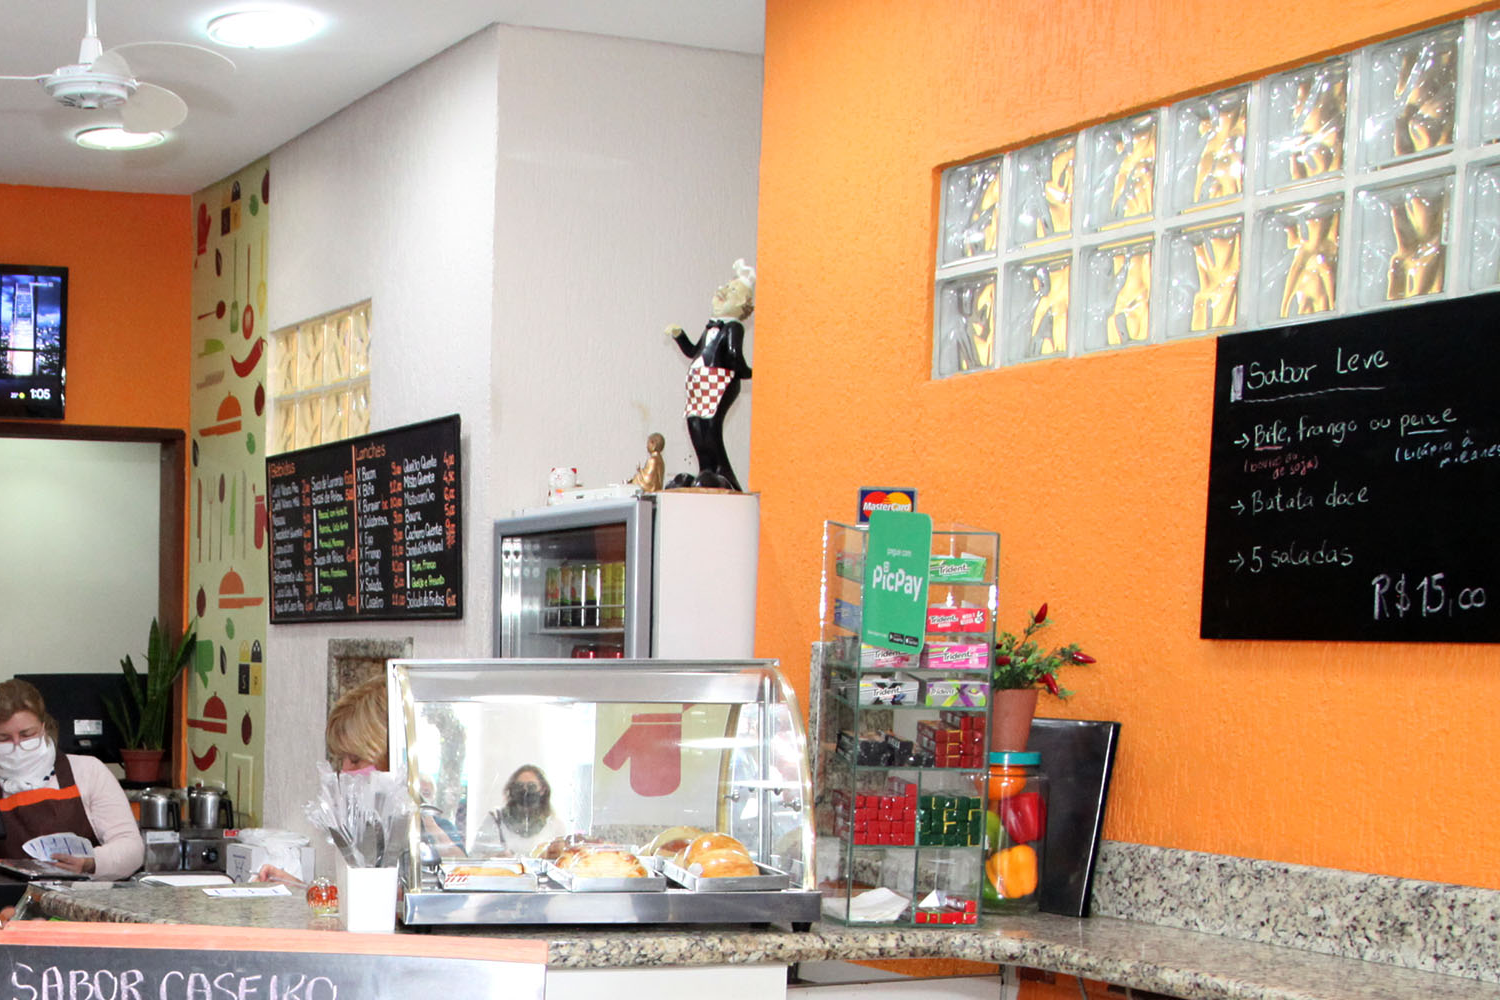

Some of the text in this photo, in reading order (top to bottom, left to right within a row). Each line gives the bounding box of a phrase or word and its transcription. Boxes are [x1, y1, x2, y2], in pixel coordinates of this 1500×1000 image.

[1247, 347, 1389, 390] Sabor Leve
[29, 388, 51, 400] 1:05
[1369, 418, 1391, 431] ou
[1400, 408, 1458, 437] peixe
[863, 502, 911, 511] MasterCard
[1250, 539, 1353, 573] 5 saladas
[872, 564, 923, 602] PicPay
